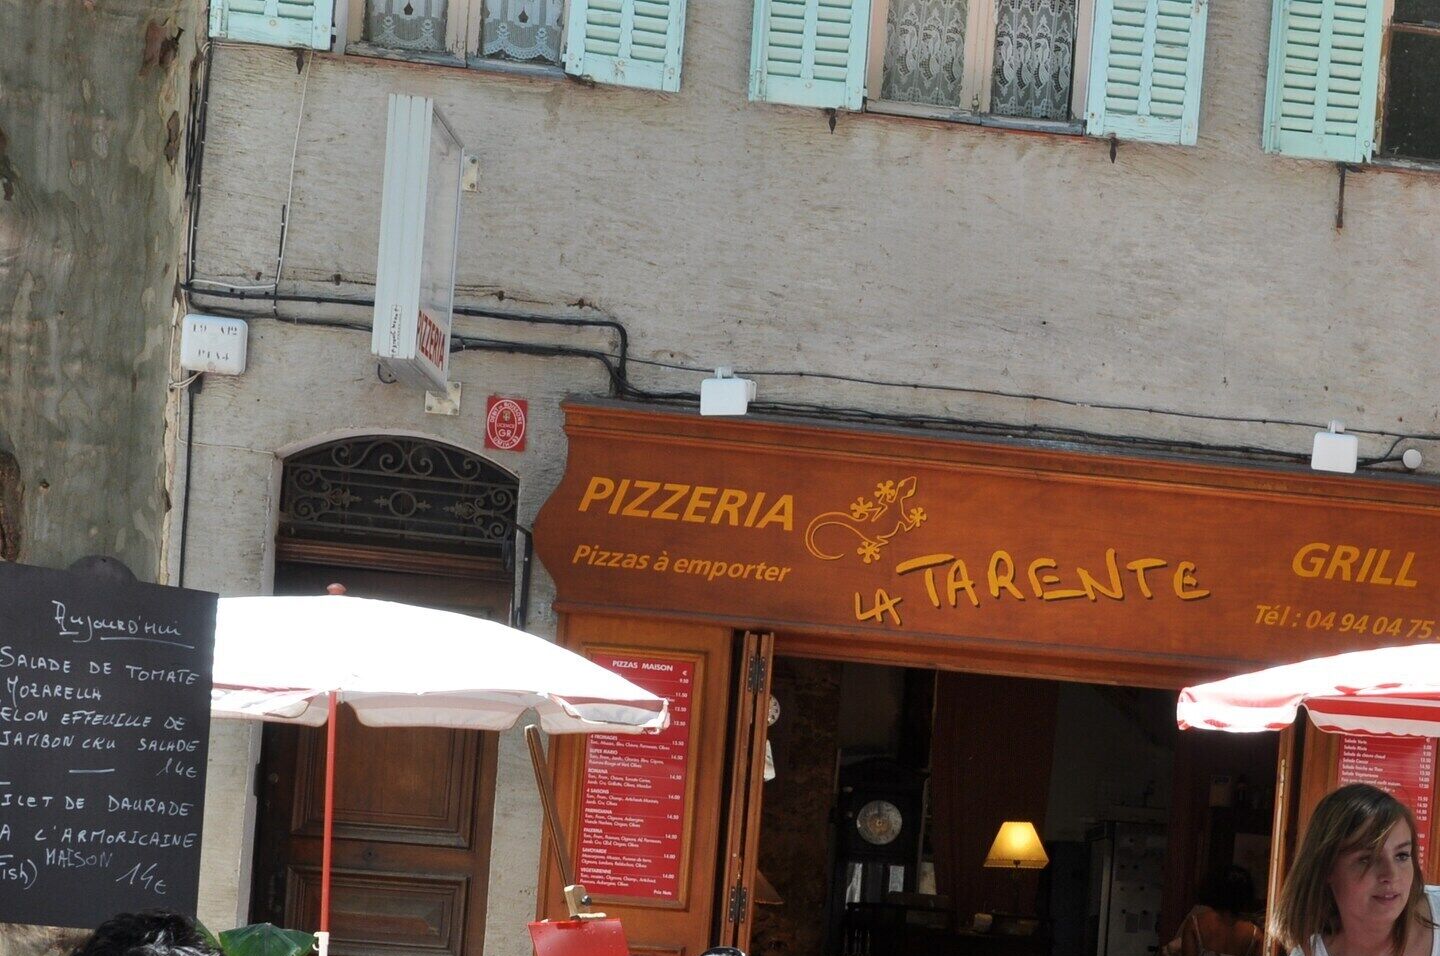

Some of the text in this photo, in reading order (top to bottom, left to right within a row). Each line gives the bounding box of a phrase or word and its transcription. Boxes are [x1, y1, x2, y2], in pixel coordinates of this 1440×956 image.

[577, 476, 794, 532] PIZZERIA
[572, 544, 792, 583] Pizzas à emporter
[1292, 542, 1419, 587] GRILL
[897, 548, 1211, 608] TARENTE
[854, 588, 903, 625] LA
[1305, 610, 1336, 631] 04
[1339, 613, 1369, 634] 94
[1372, 616, 1403, 637] 04
[1405, 619, 1435, 639] 75
[89, 661, 112, 675] DE
[125, 664, 200, 685] TOMATE
[612, 660, 674, 672] PIZZAS MAISON
[7, 676, 102, 708] MOZARELLA
[0, 707, 186, 731] ELON EFFEUILLE DE
[0, 730, 200, 752] JAMBON CRU SALADE
[65, 796, 85, 810] DE
[107, 795, 194, 816] DAURADE
[34, 826, 198, 848] L'ARMORICAINE
[45, 848, 114, 868] MAISON
